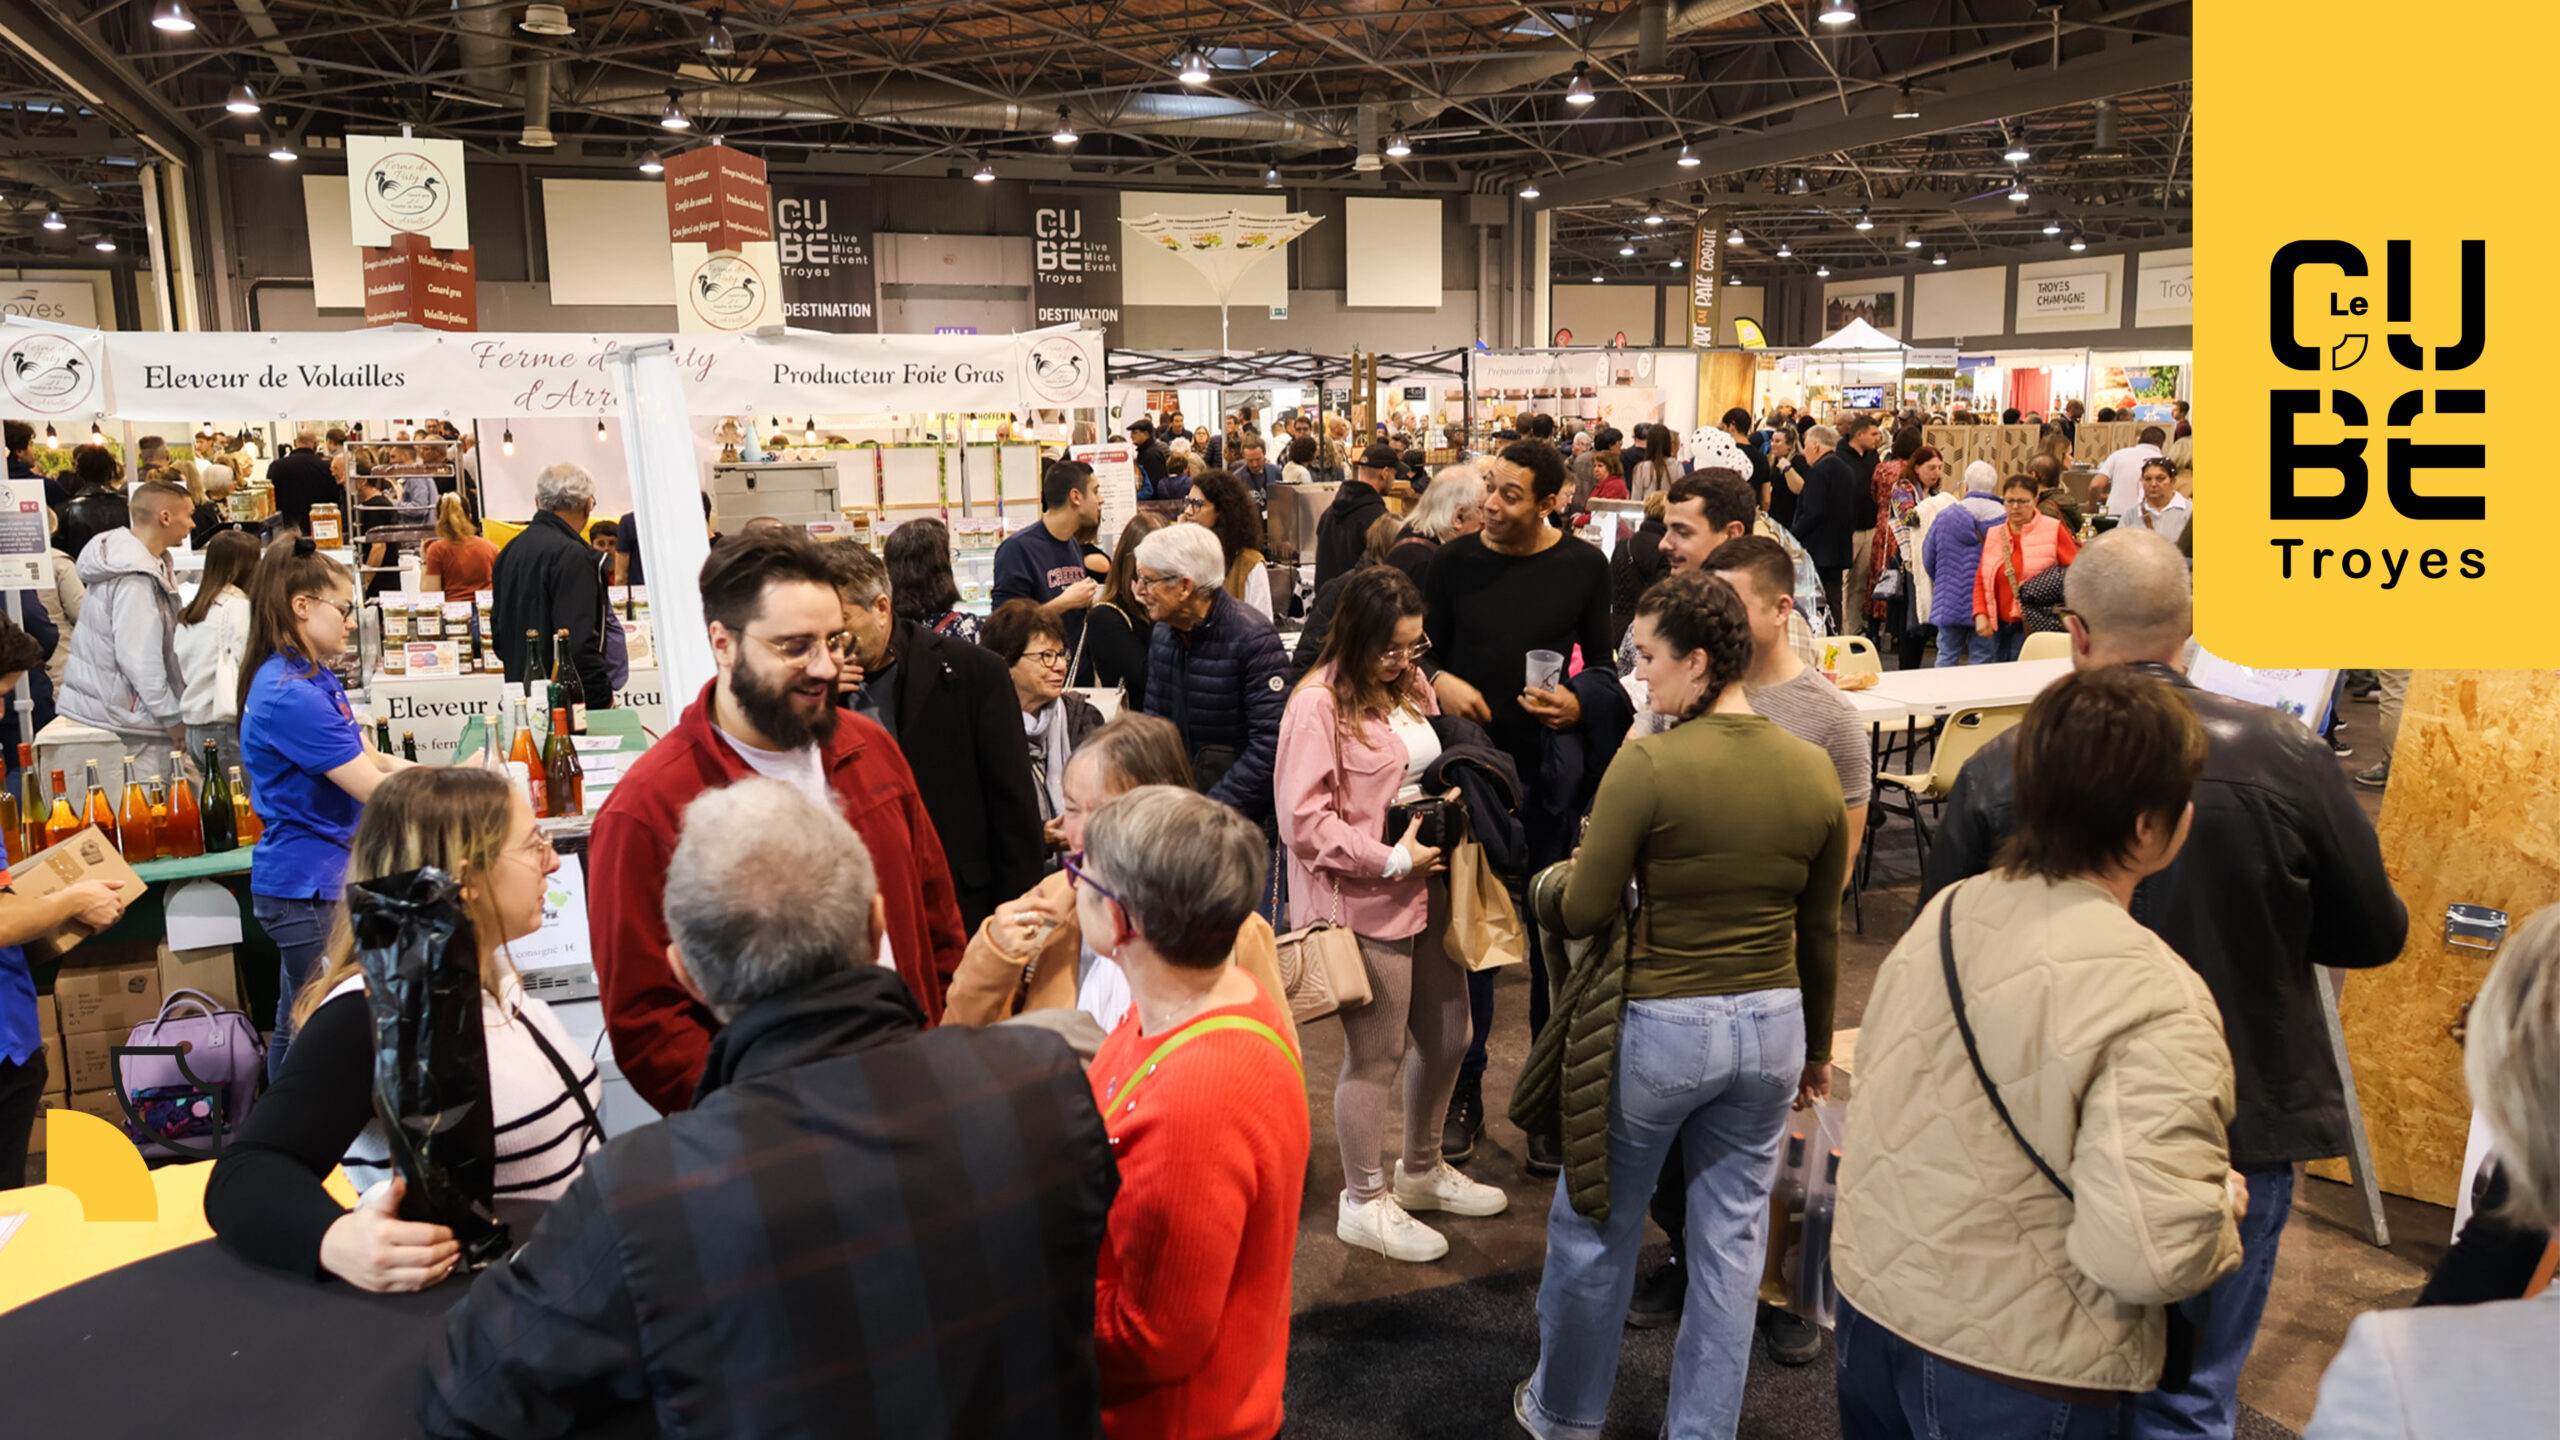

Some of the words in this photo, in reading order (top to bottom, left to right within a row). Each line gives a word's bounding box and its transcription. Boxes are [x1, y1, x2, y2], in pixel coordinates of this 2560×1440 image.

[831, 233, 858, 243] Live
[831, 244, 861, 254] Mice
[1084, 242, 1108, 251] Live
[832, 255, 869, 265] Event
[1084, 252, 1111, 262] Mice
[781, 265, 831, 279] Troyes
[1084, 262, 1117, 272] Event
[1038, 272, 1083, 285] Troyes
[2038, 280, 2070, 294] TROYES
[2037, 292, 2086, 307] CHAMPAGNE
[784, 302, 872, 318] DESTINATION
[1038, 307, 1118, 322] DESTINATION
[470, 340, 578, 370] Ferme
[143, 364, 249, 389] Eleveur
[258, 364, 288, 388] de
[296, 363, 406, 388] Volailles
[773, 362, 896, 385] Producteur
[902, 362, 947, 384] Foie
[954, 362, 1005, 384] Gras
[386, 696, 488, 720] Eleveur
